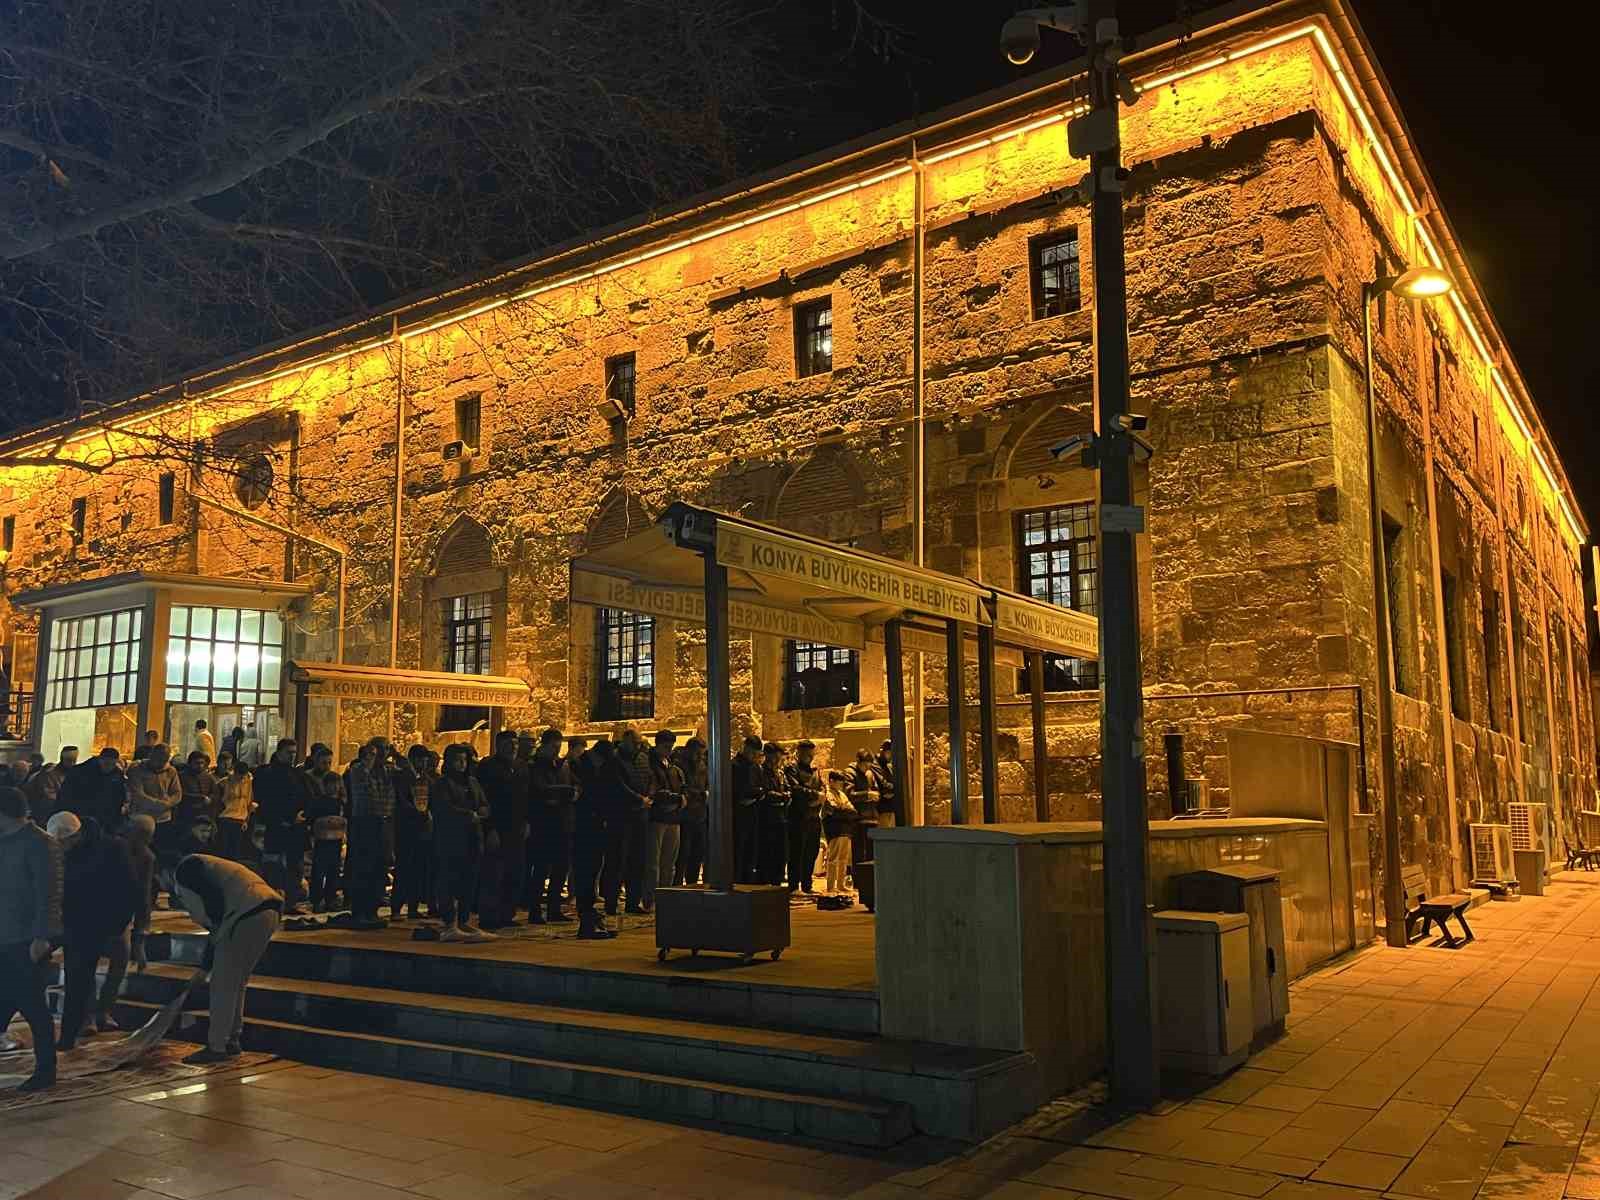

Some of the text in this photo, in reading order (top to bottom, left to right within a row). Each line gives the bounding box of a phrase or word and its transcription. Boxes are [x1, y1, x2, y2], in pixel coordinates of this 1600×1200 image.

[752, 544, 806, 576] KONYA
[903, 582, 970, 615] BELEDİYESİ
[1014, 608, 1043, 633] KONYA
[334, 682, 375, 695] KONYA
